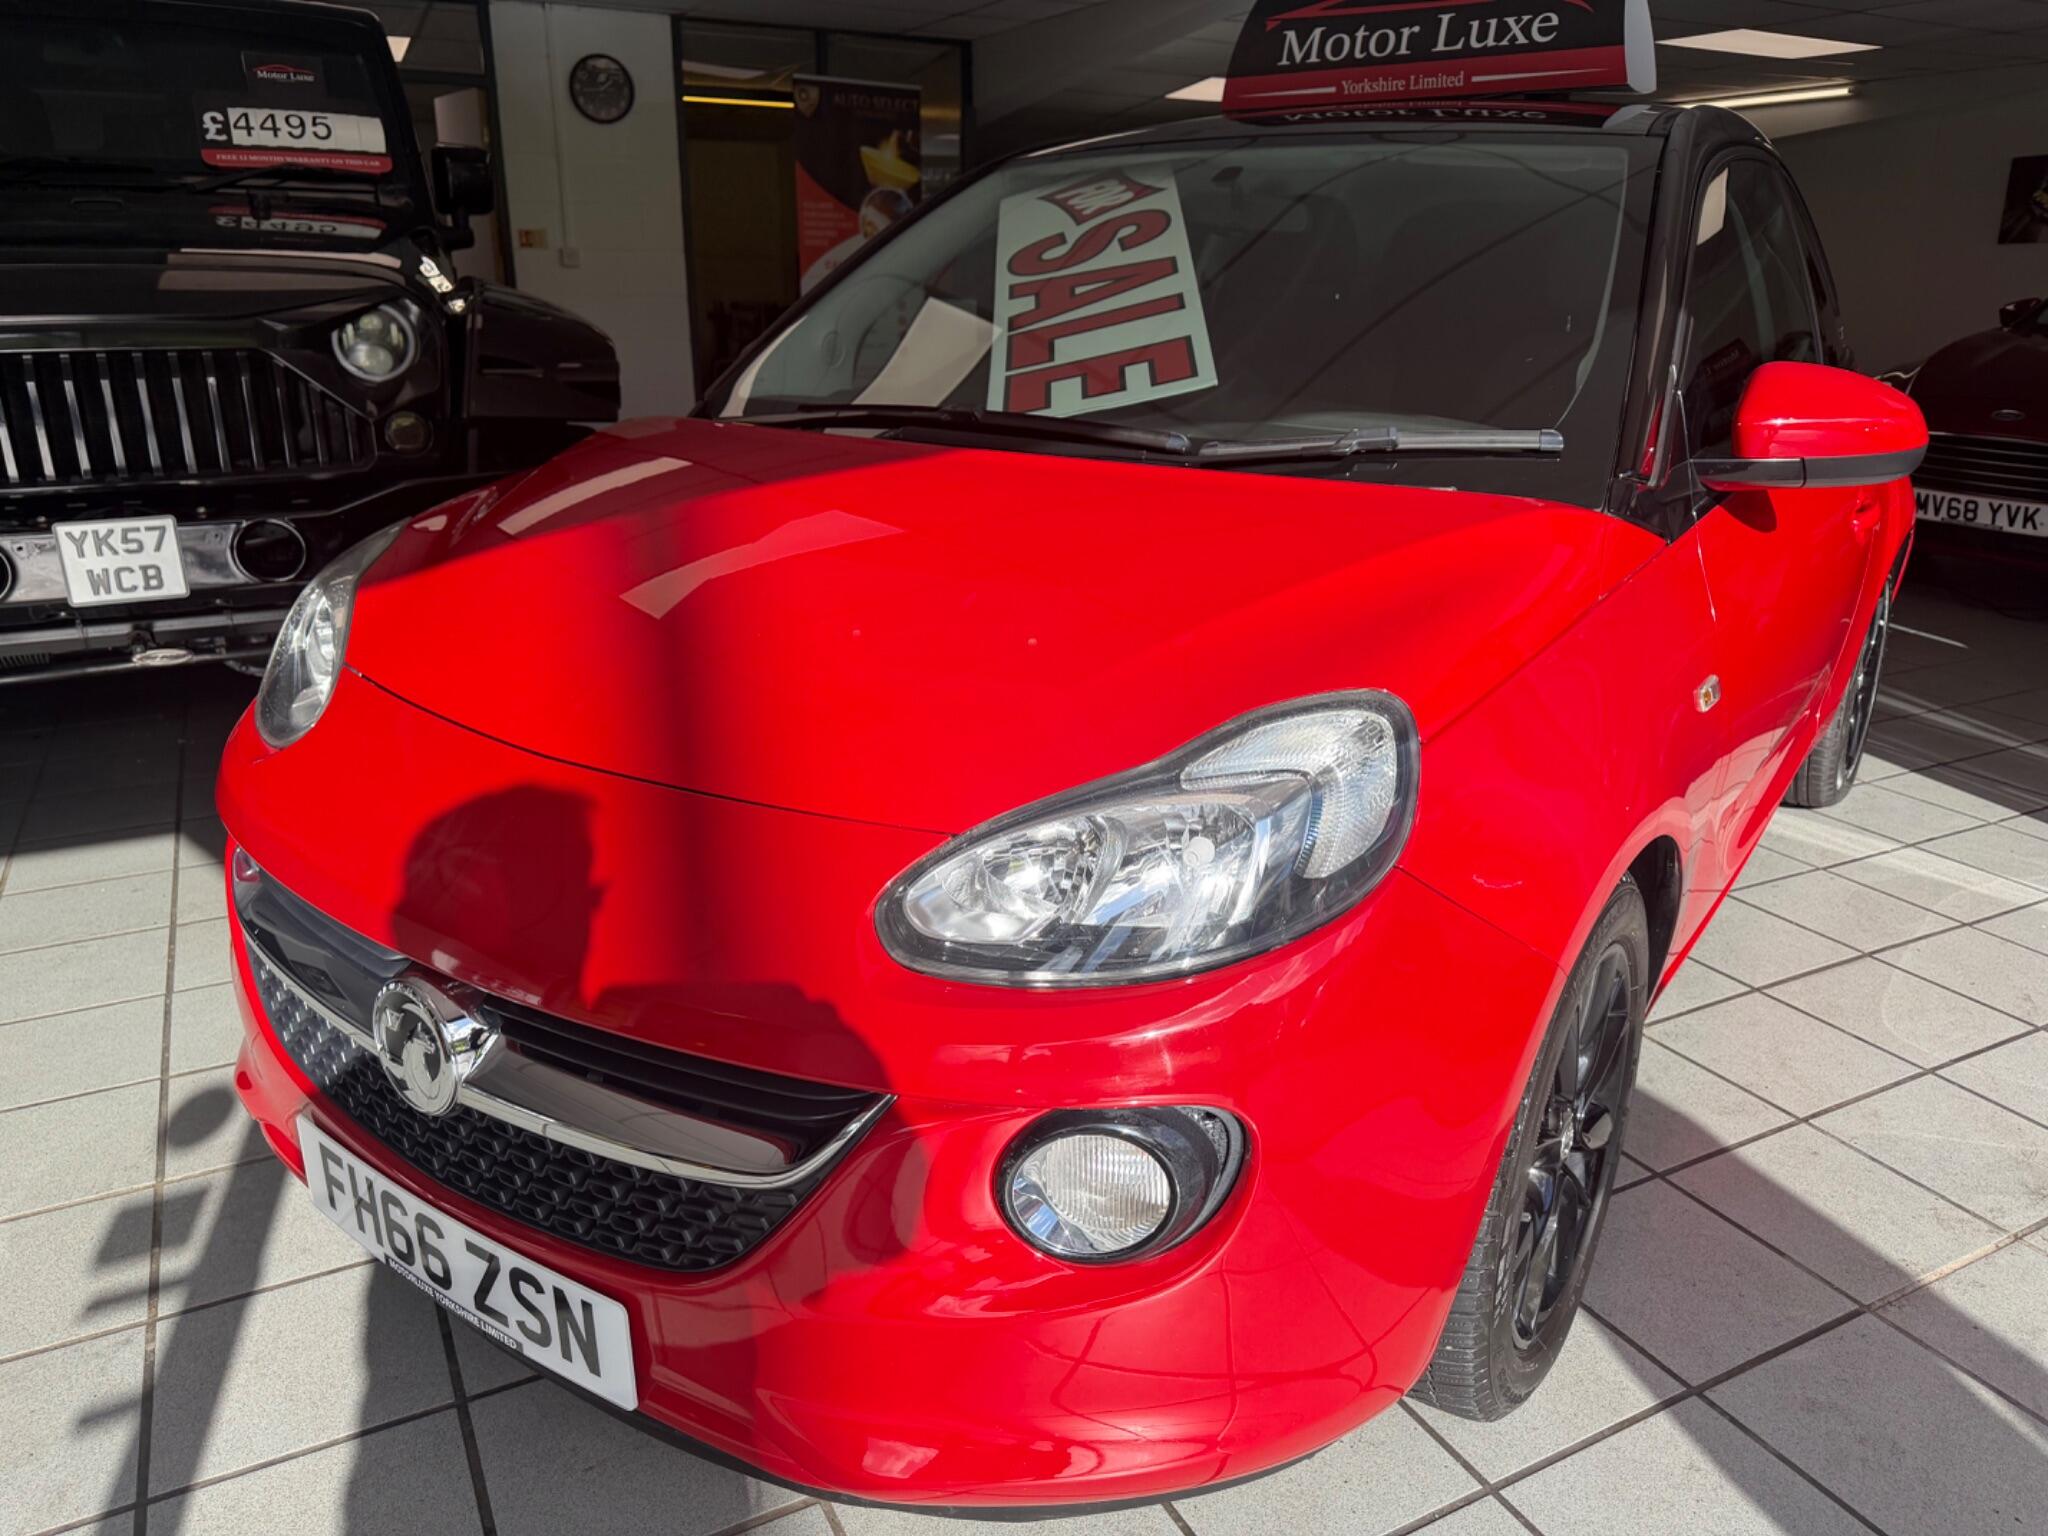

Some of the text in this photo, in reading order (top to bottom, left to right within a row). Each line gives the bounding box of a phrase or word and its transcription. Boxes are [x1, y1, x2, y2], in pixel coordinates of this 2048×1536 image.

[1277, 11, 1560, 66] Motor Luxe
[257, 70, 288, 80] Motor
[290, 72, 315, 82] Luxe
[1341, 70, 1465, 95] Yorkshire Limited
[202, 111, 333, 141] £4495
[1003, 178, 1199, 412] FOR SALE
[1916, 491, 1979, 522] MV68
[1988, 502, 2041, 531] YVK
[64, 526, 167, 559] YK57
[86, 564, 164, 596] WCB
[319, 1141, 602, 1378] FH66 ZSN
[481, 1321, 518, 1350] LIMITED
